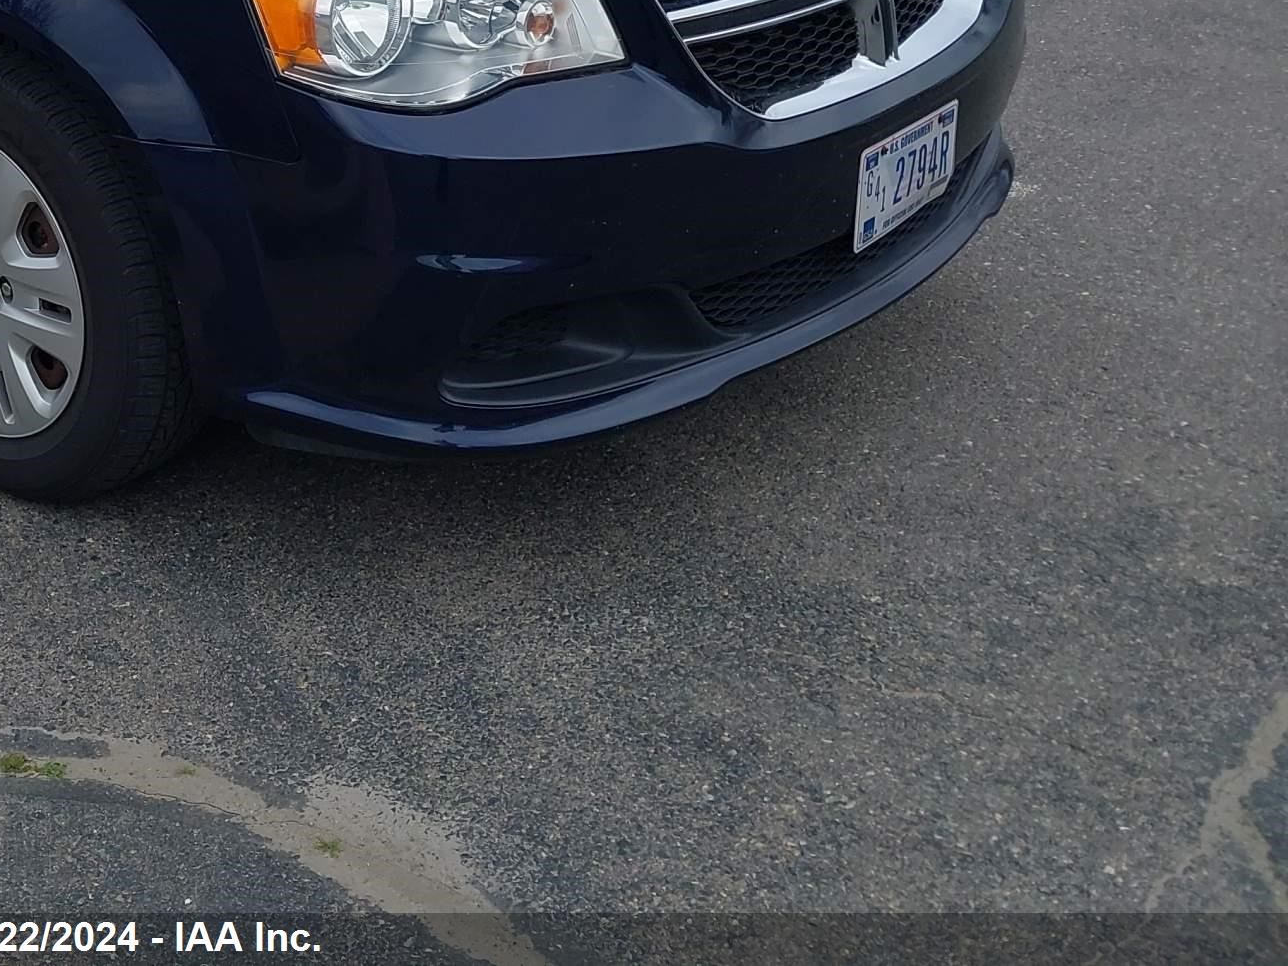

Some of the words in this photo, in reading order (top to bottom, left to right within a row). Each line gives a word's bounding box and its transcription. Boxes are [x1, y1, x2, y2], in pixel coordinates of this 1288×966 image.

[890, 140, 900, 155] U.S.
[900, 121, 934, 149] GOVERNMENT
[893, 131, 950, 205] 2794R
